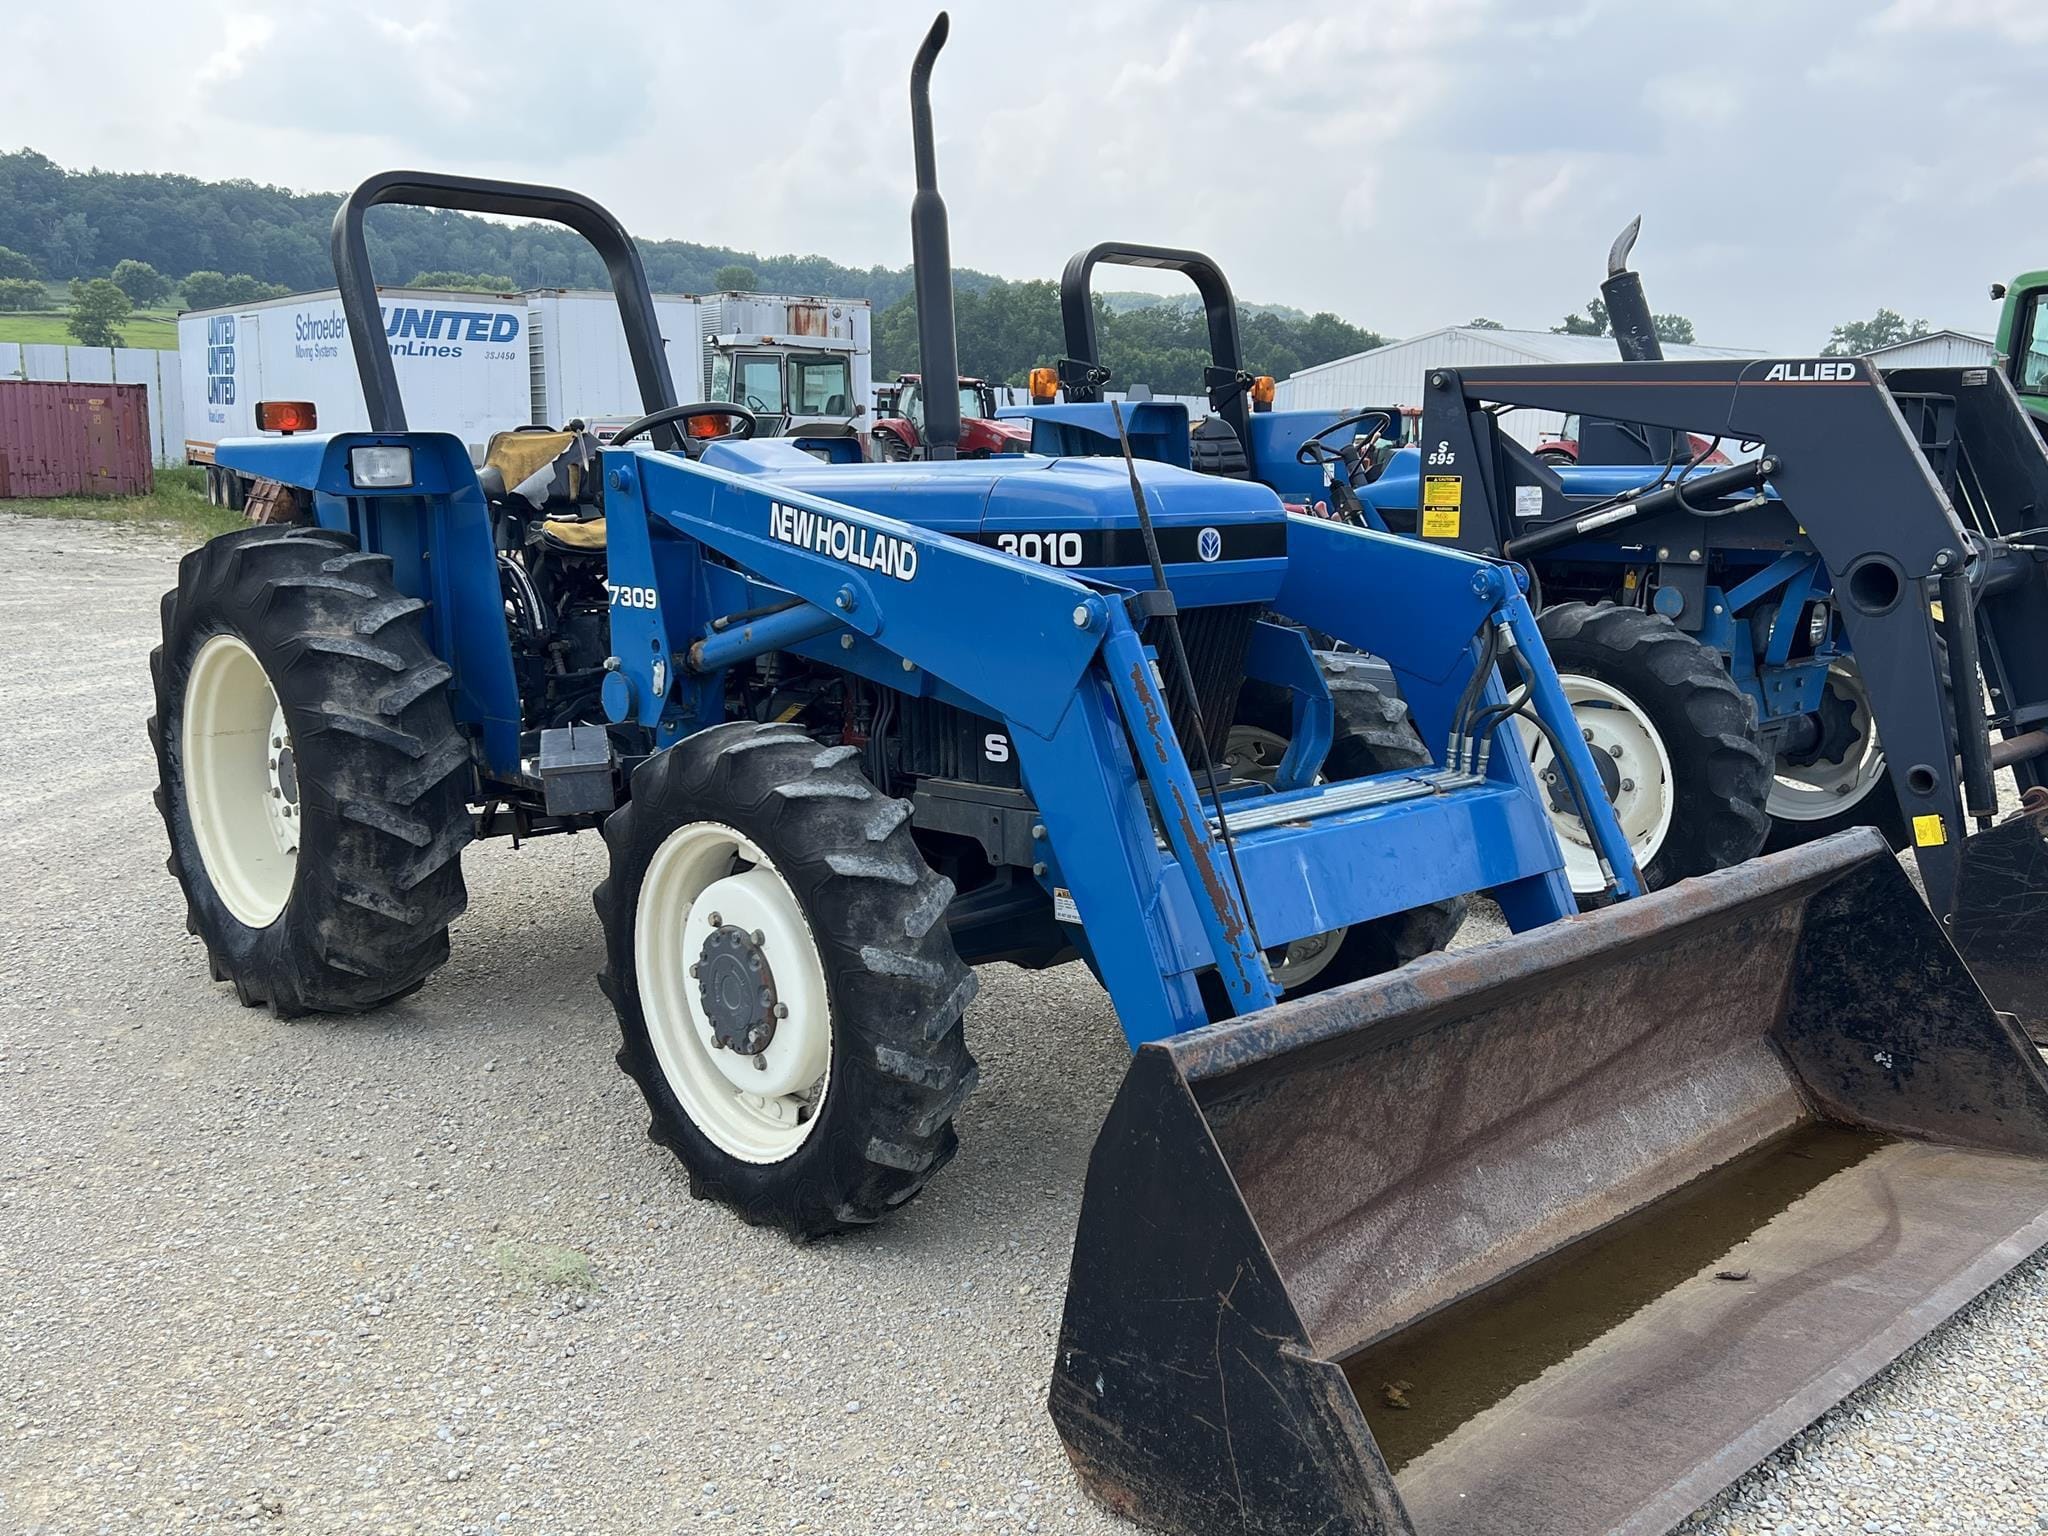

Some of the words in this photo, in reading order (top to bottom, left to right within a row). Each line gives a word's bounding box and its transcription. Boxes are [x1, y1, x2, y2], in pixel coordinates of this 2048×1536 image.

[207, 315, 235, 346] UNITED
[295, 309, 345, 342] Schroeder
[380, 306, 519, 343] UNITED
[207, 346, 235, 376] UNITED
[1764, 363, 1856, 381] ALLIED
[207, 376, 235, 406] UNITED
[1428, 452, 1455, 465] 595
[1438, 441, 1449, 453] S
[997, 532, 1083, 566] 3010
[609, 585, 657, 610] 7309
[984, 733, 1009, 763] S
